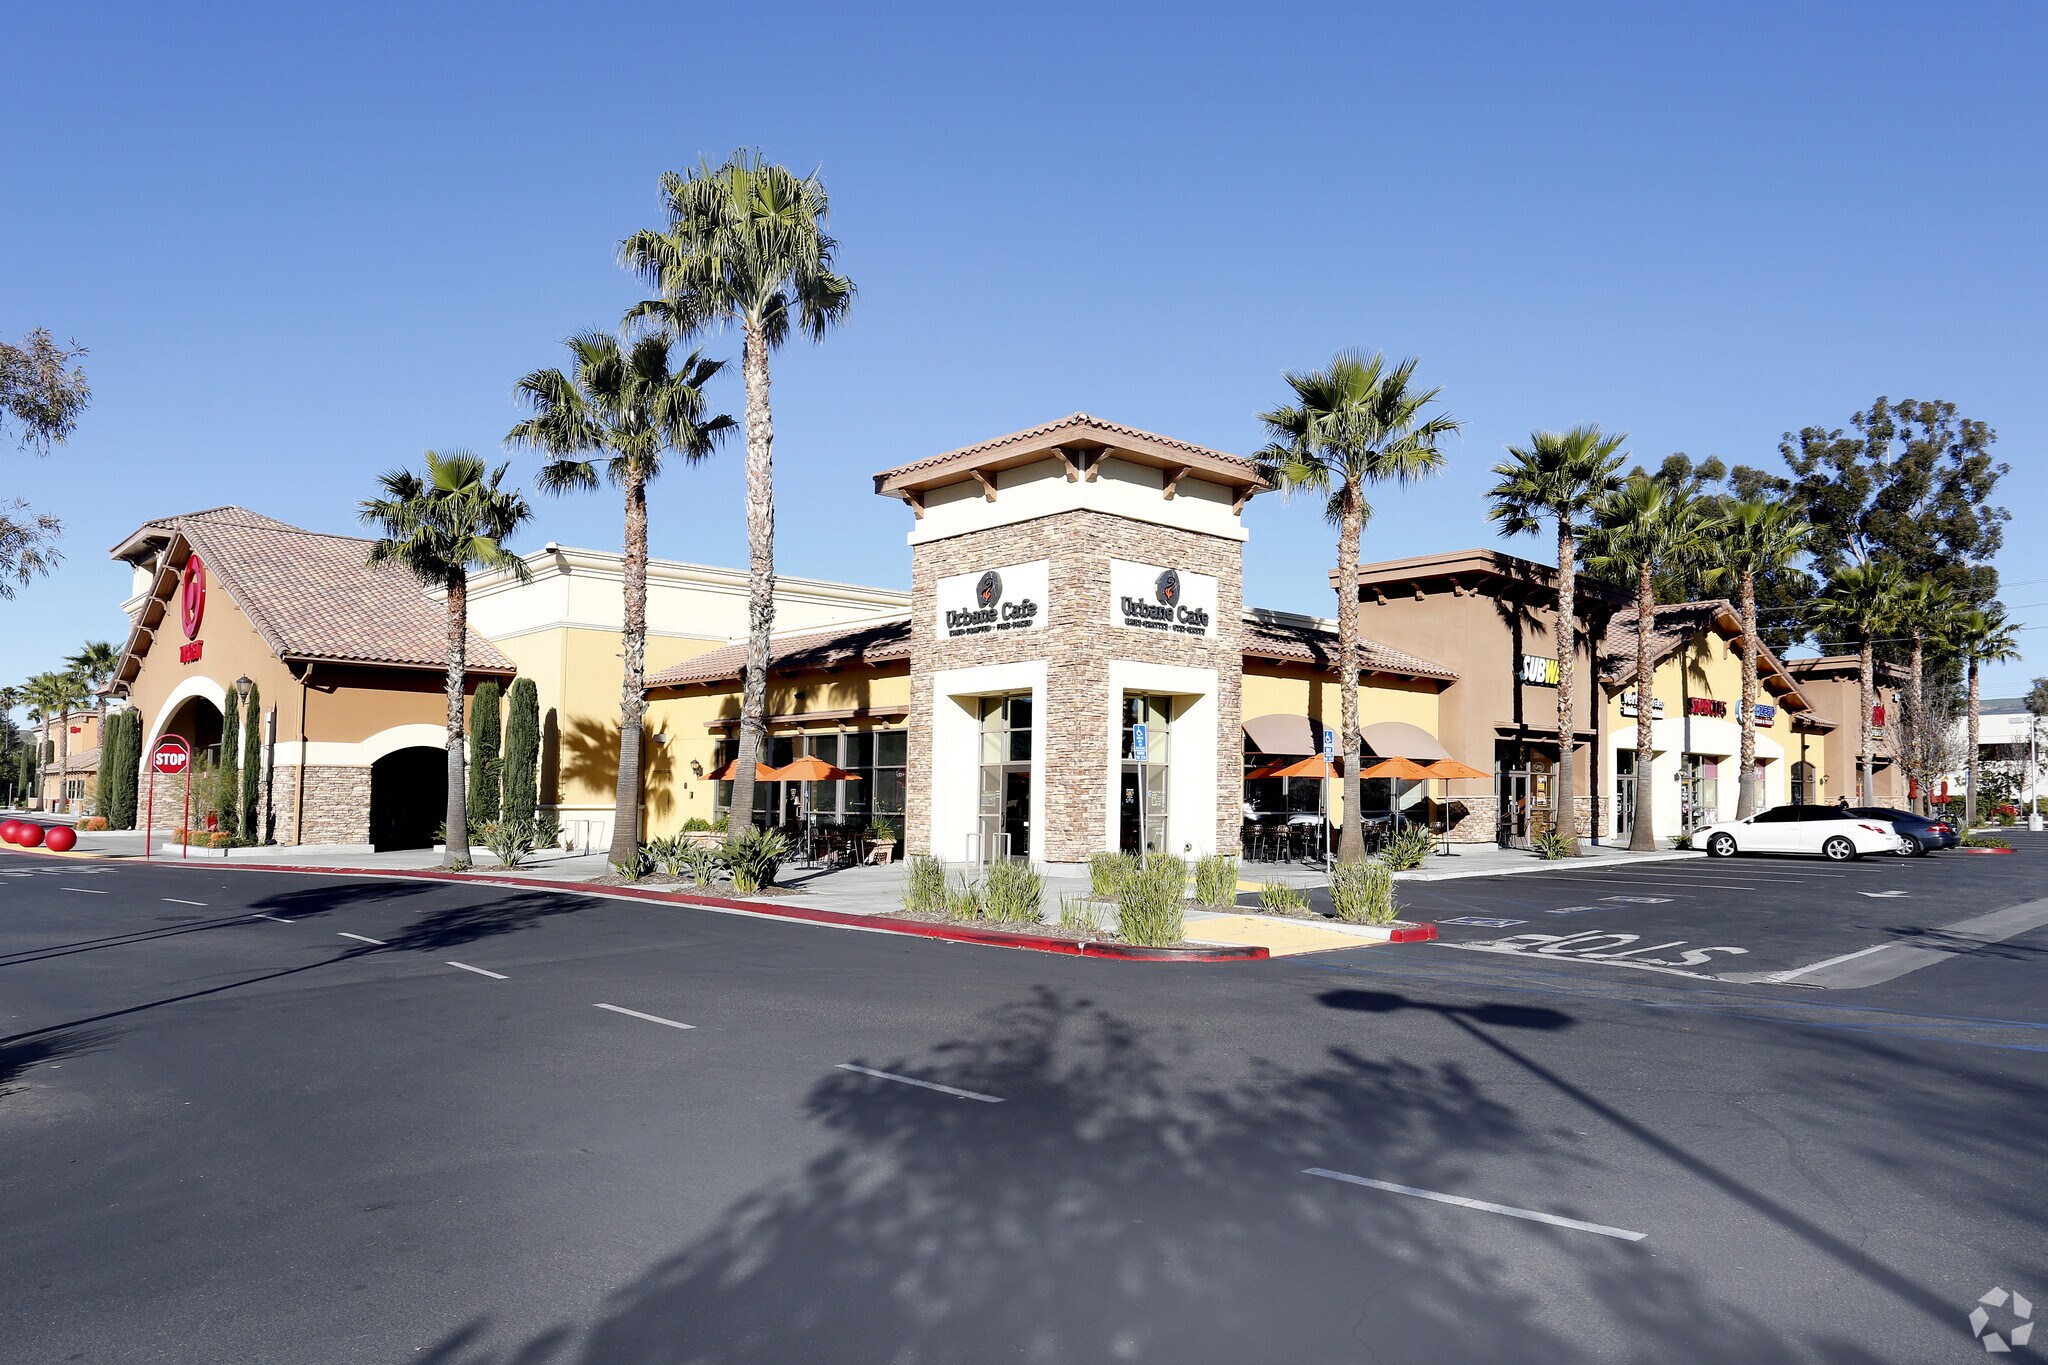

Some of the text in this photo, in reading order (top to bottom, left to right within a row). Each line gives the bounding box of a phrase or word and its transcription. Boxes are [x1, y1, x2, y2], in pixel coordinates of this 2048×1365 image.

[946, 607, 998, 629] Urbane
[1001, 598, 1038, 621] Cafe
[1121, 596, 1174, 622] Urbane
[1177, 605, 1209, 627] Cafe
[155, 753, 186, 765] STOP
